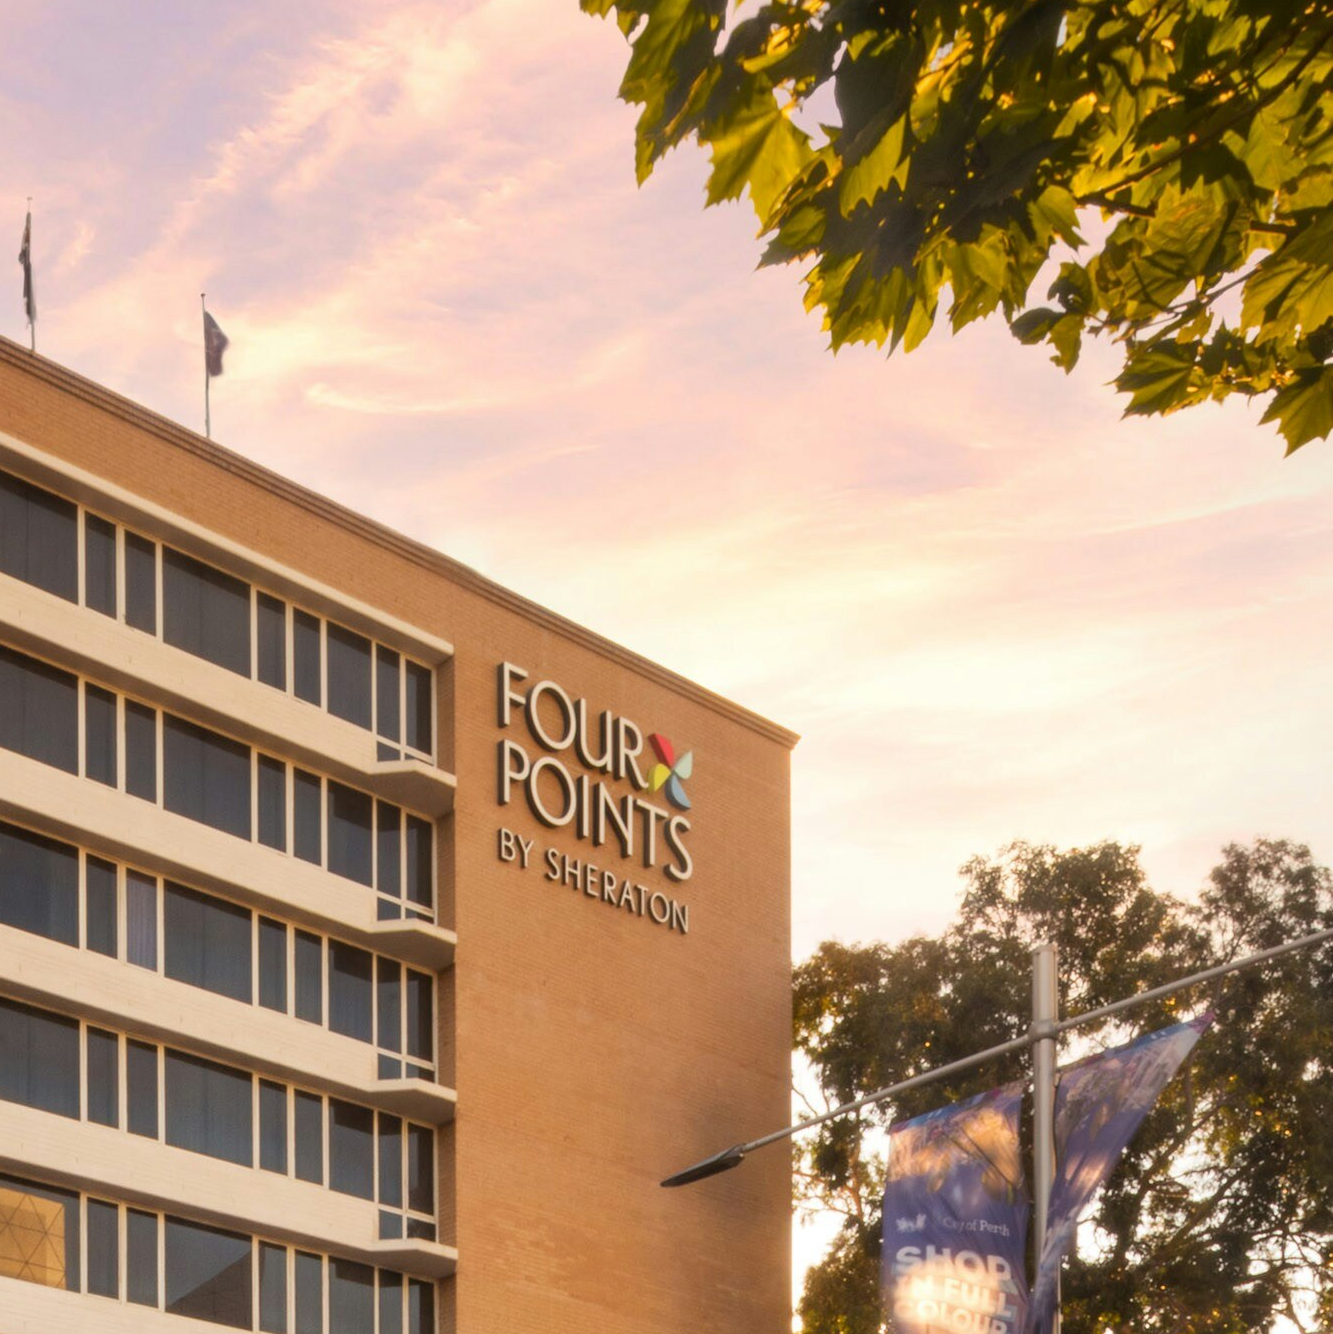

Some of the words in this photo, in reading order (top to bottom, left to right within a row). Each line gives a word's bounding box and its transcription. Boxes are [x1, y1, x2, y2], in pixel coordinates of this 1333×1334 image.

[498, 661, 649, 790] FOUR
[498, 739, 693, 881] POINTS
[499, 827, 534, 868] BY
[546, 847, 689, 934] SHERATON
[896, 1244, 1012, 1284] SHOP
[980, 1219, 1010, 1237] Perth
[944, 1277, 1012, 1318] FULL
